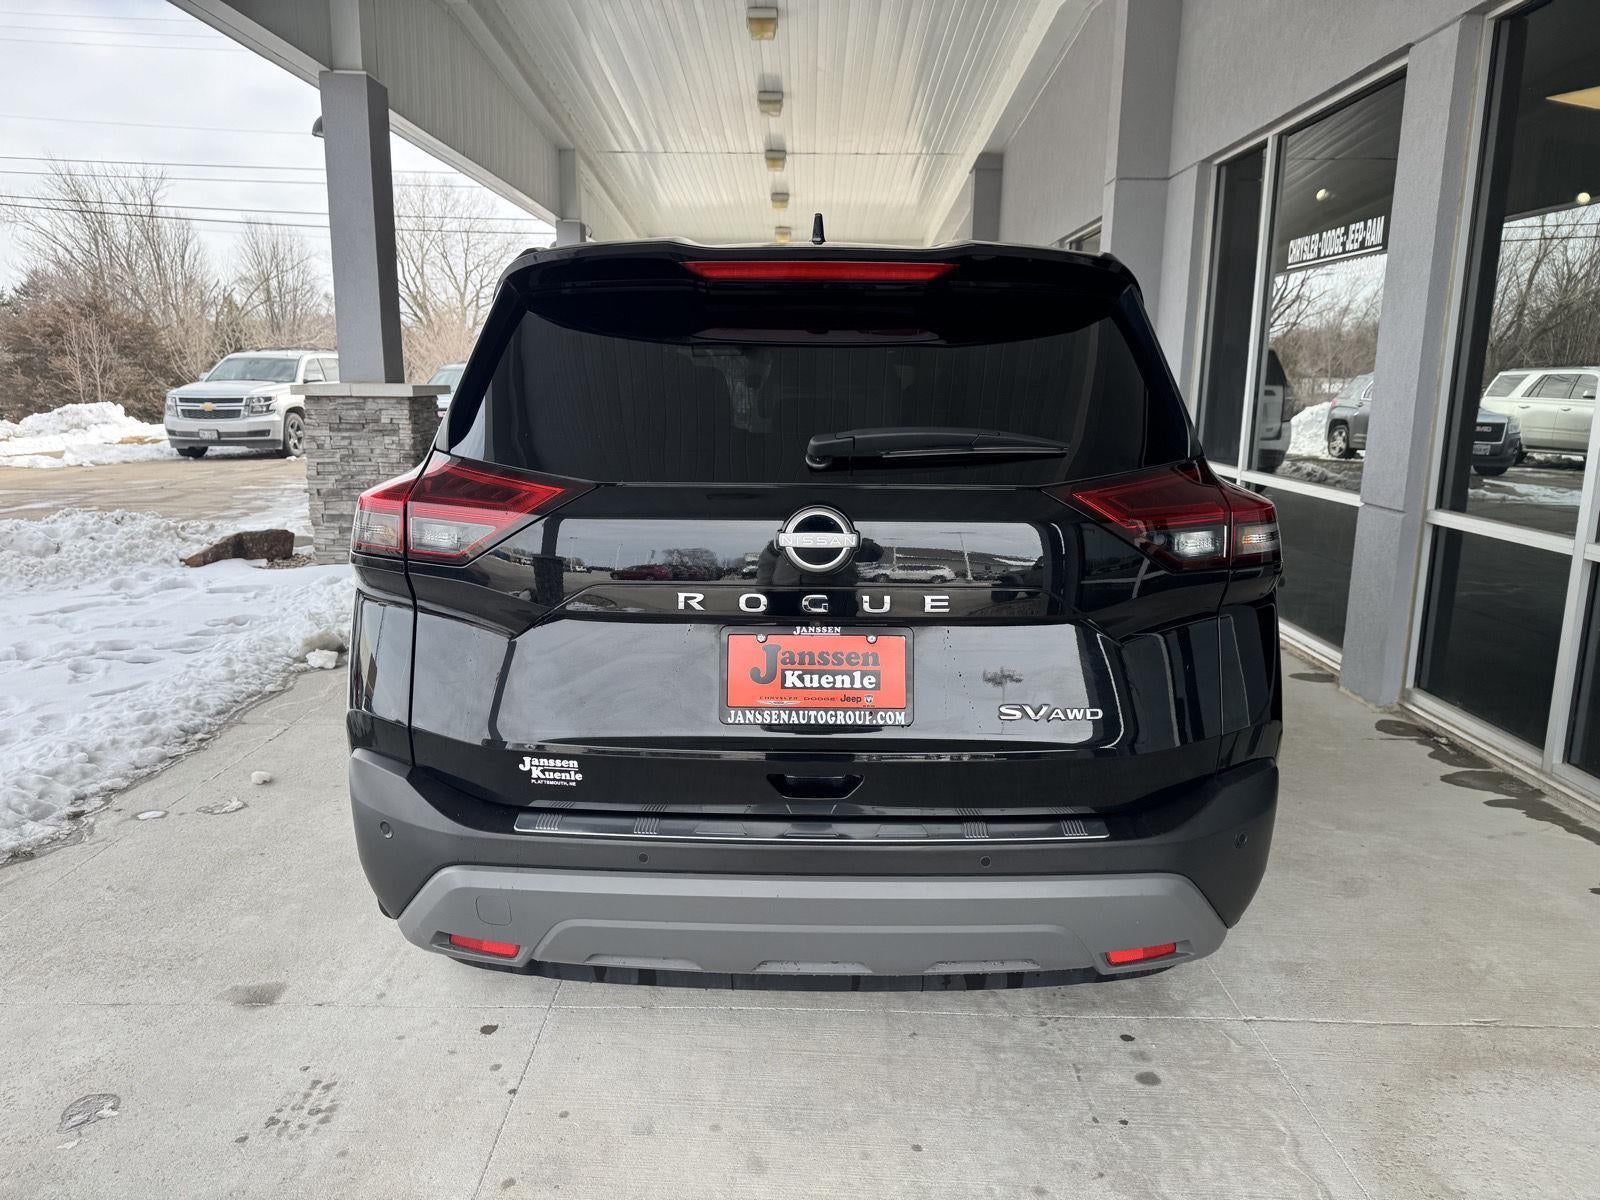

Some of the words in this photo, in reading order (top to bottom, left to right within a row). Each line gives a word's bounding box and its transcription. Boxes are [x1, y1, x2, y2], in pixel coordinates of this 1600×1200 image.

[781, 536, 857, 546] NISSAN
[677, 592, 952, 614] ROGUE
[792, 626, 841, 635] JANSSEN
[750, 644, 880, 684] Janssen
[784, 670, 876, 689] Kuenle
[840, 694, 862, 704] Jeep
[999, 704, 1049, 721] SV
[1047, 707, 1104, 721] AWD
[519, 756, 578, 771] Janssen
[531, 766, 583, 780] Kuenle
